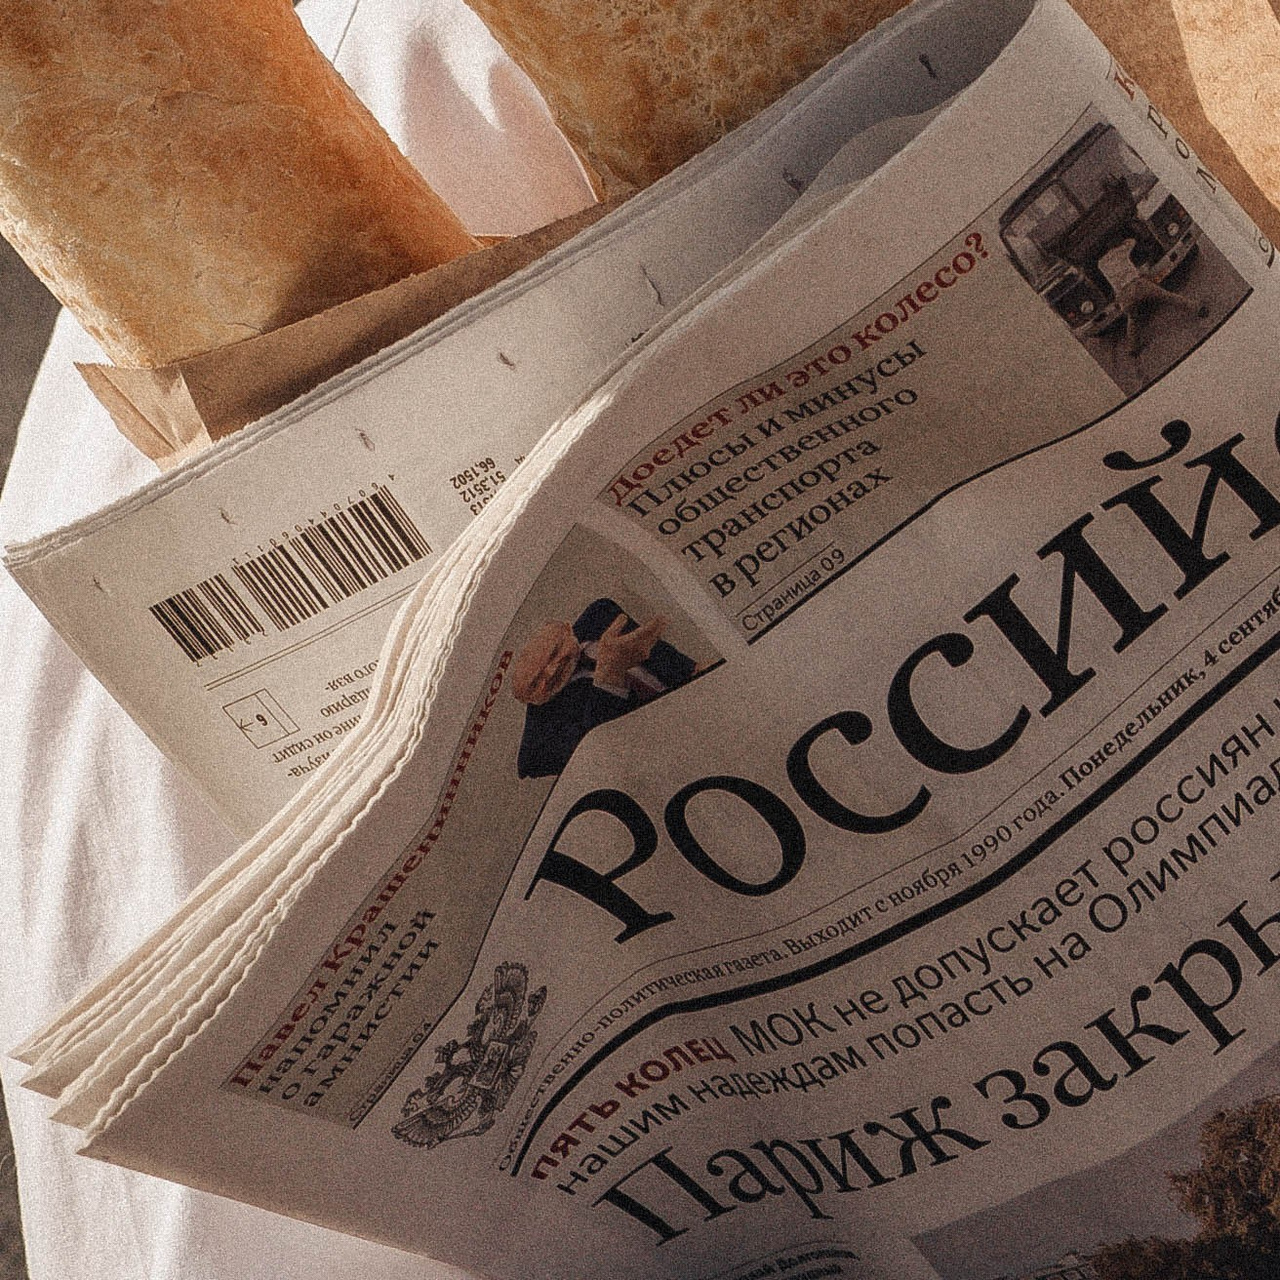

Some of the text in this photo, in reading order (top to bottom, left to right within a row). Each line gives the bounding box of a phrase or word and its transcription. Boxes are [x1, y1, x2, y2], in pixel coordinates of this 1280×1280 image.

[606, 231, 990, 507] Доедет ли это колесо?
[627, 339, 928, 520] Плюсы и минусы
[450, 457, 496, 489] 66,1502
[459, 470, 507, 503] 51,3512
[657, 387, 920, 537] общественного
[681, 439, 882, 566] транспорта
[708, 464, 894, 598] в регионах
[741, 547, 846, 633] Страница 09
[256, 713, 268, 727] 6
[313, 729, 333, 745] он
[353, 658, 380, 681] ого
[272, 739, 314, 765] сидит
[720, 946, 788, 978] газета.
[781, 903, 873, 963] Выходит
[885, 861, 963, 908] ноября
[961, 824, 1013, 871] 1990
[1010, 786, 1064, 834] года.
[1059, 666, 1208, 791] Понедельник,
[1202, 649, 1219, 670] 4
[258, 918, 397, 1095] напомнил
[282, 907, 437, 1101] о гаражной
[530, 1095, 621, 1181] ПЯТЬ
[614, 1036, 738, 1098] КОЛЕЦ
[729, 1001, 837, 1058] МОК
[833, 987, 889, 1032] не
[892, 856, 1103, 1009] допускает
[1102, 711, 1277, 878] россиян
[230, 980, 329, 1088] Павел
[302, 939, 441, 1108] амнистии
[556, 1091, 693, 1196] нашим
[687, 1045, 871, 1104] надеждам
[867, 971, 1036, 1062] попасть
[1031, 928, 1094, 982] на
[592, 1095, 993, 1247] Париж
